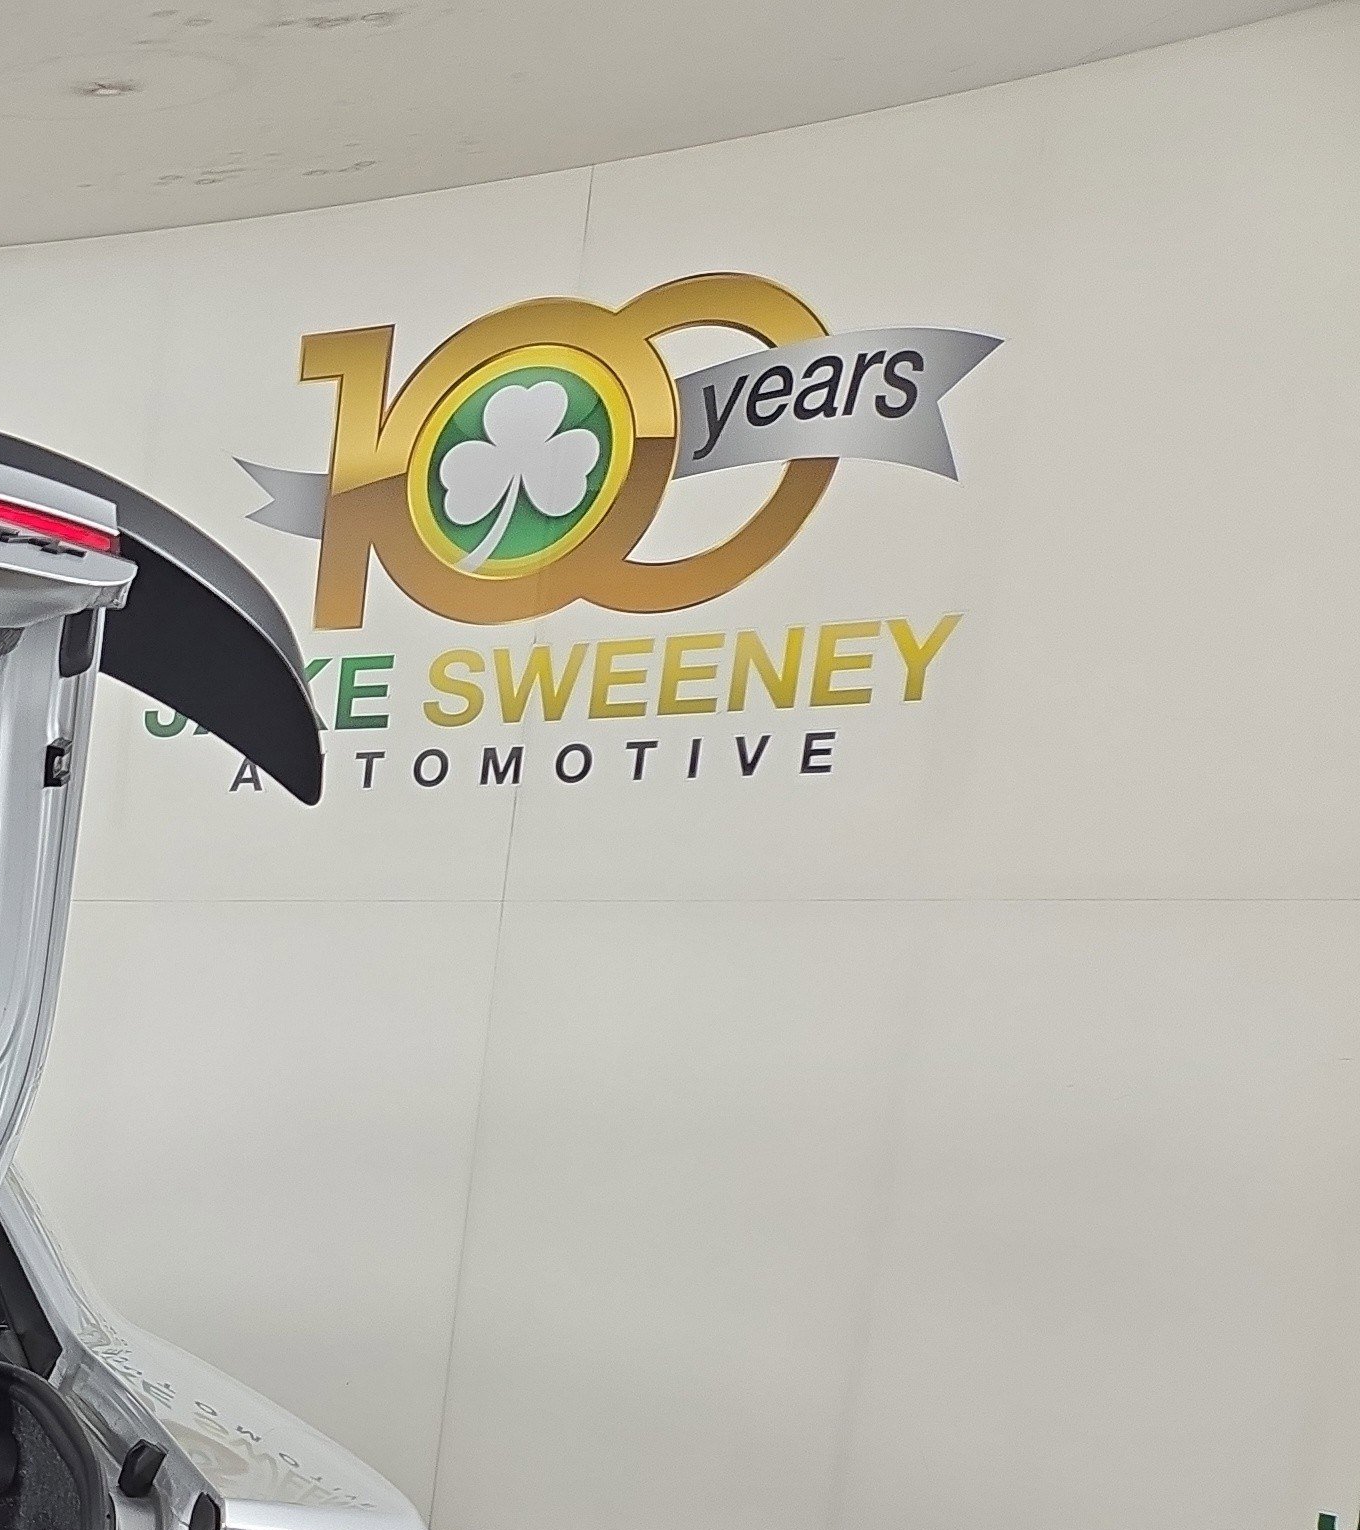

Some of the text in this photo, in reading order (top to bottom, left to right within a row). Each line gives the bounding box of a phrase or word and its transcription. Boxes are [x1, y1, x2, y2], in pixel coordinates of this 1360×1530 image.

[691, 346, 925, 462] years
[423, 614, 963, 727] SWEENEY
[229, 732, 838, 792] ATOMOTIVE
